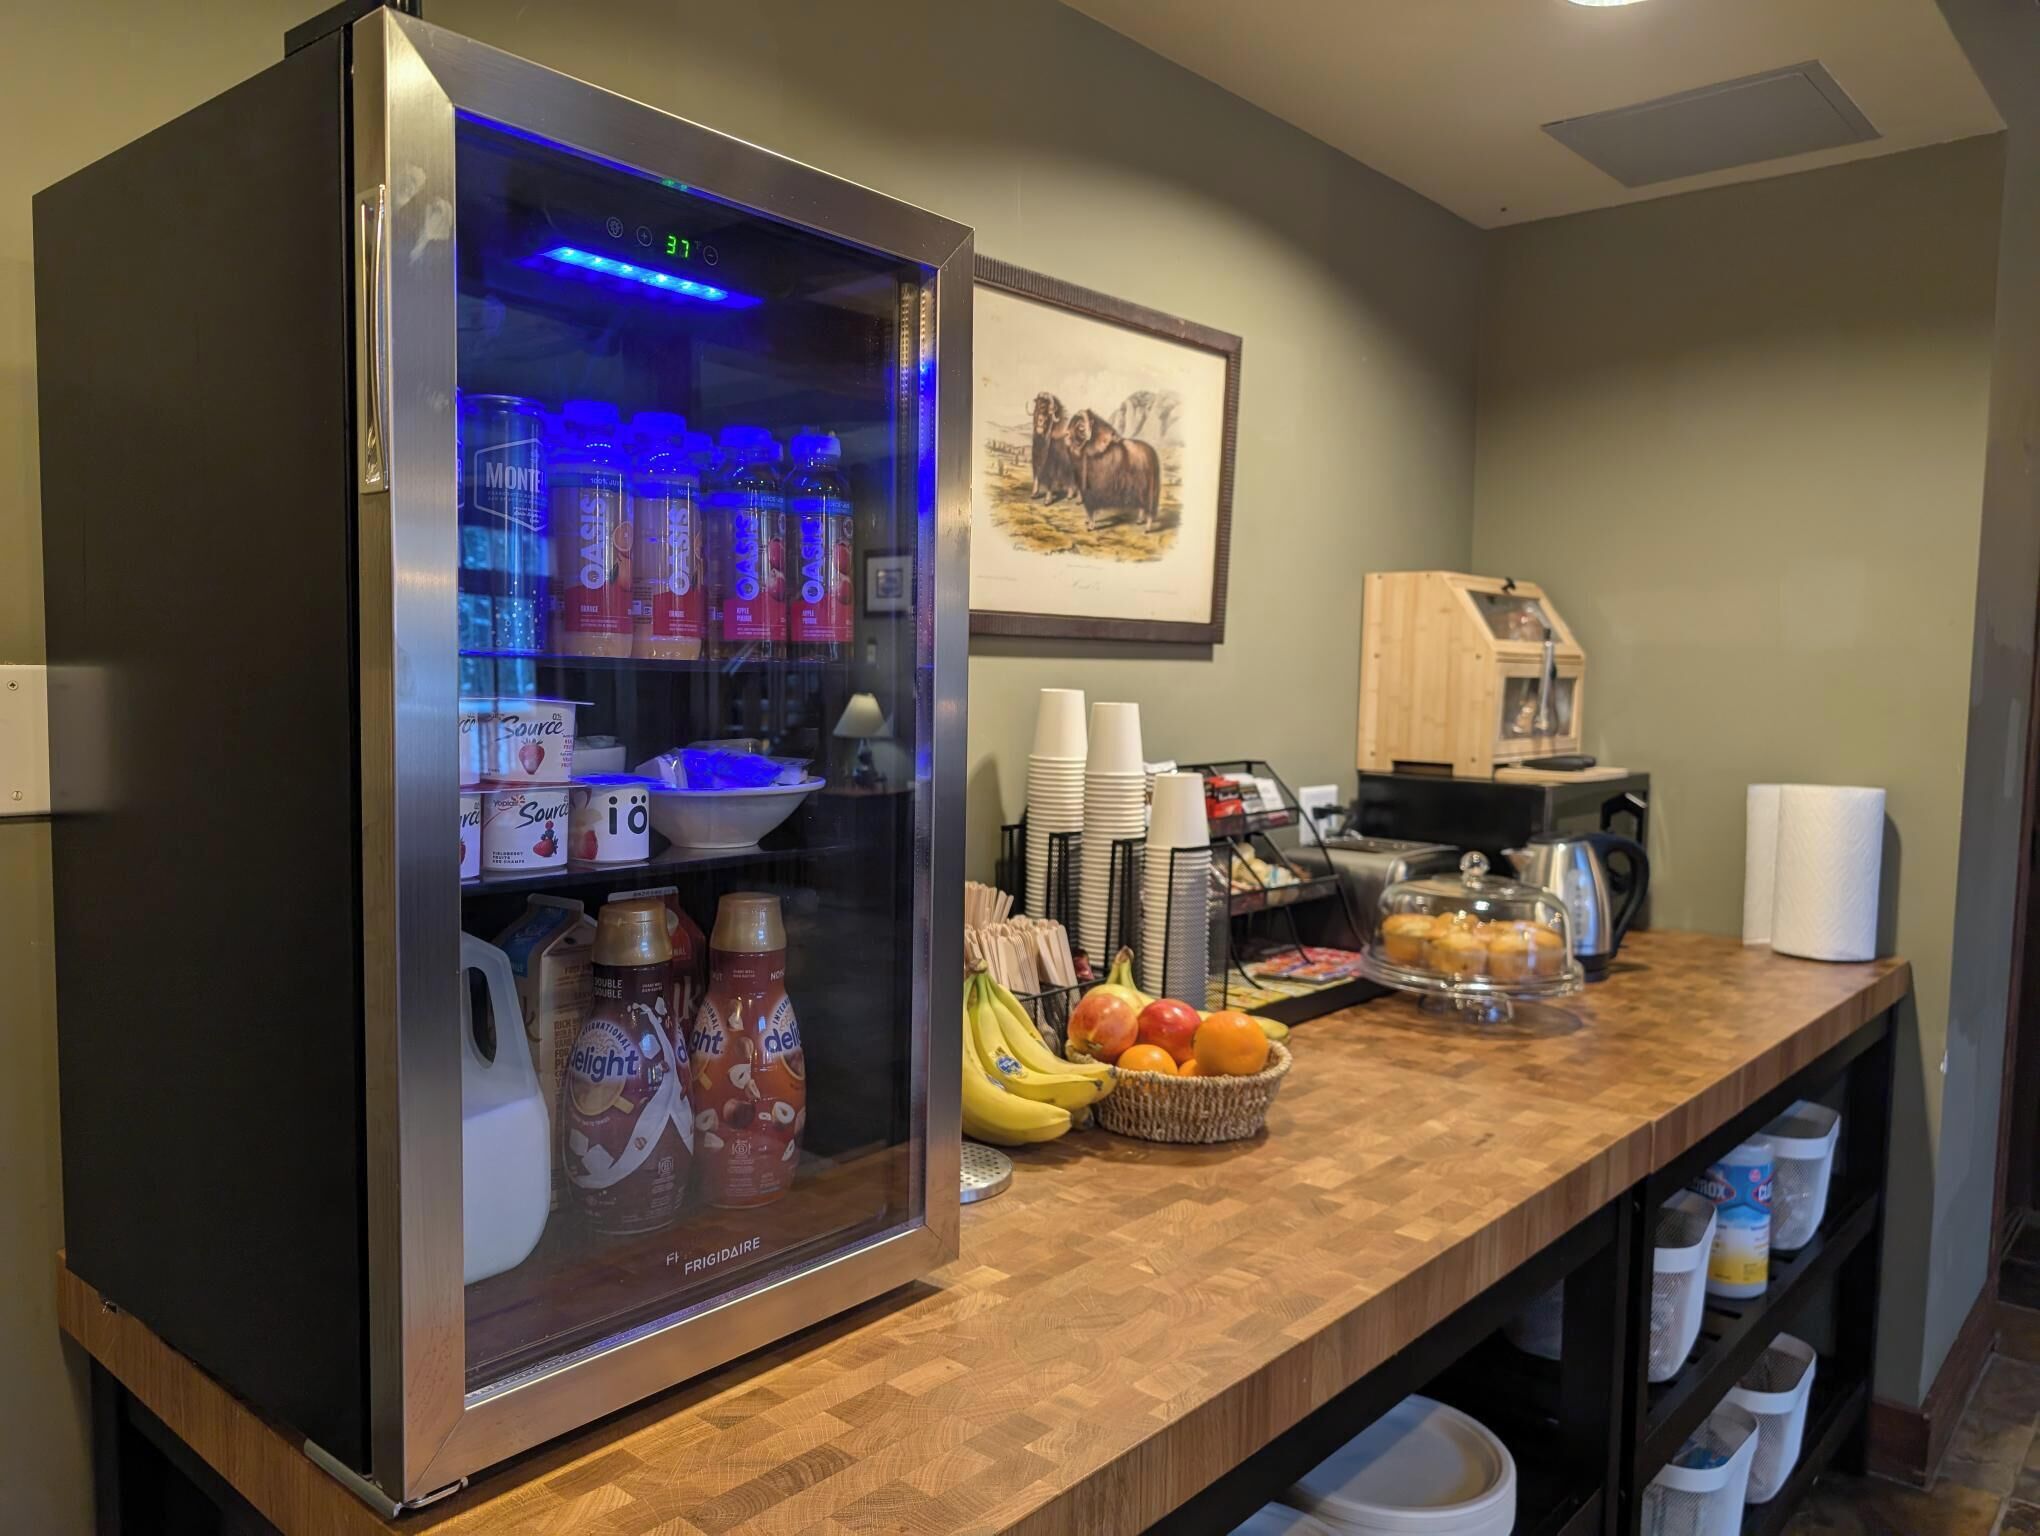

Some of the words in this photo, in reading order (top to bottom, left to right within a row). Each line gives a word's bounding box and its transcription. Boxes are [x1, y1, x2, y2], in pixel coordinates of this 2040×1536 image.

[666, 235, 689, 258] 37
[580, 495, 606, 589] OASIS
[668, 504, 690, 596] OASIS
[735, 511, 759, 601] OASIS
[802, 518, 825, 604] OASIS
[684, 1236, 761, 1276] FRIGIDAIRE
